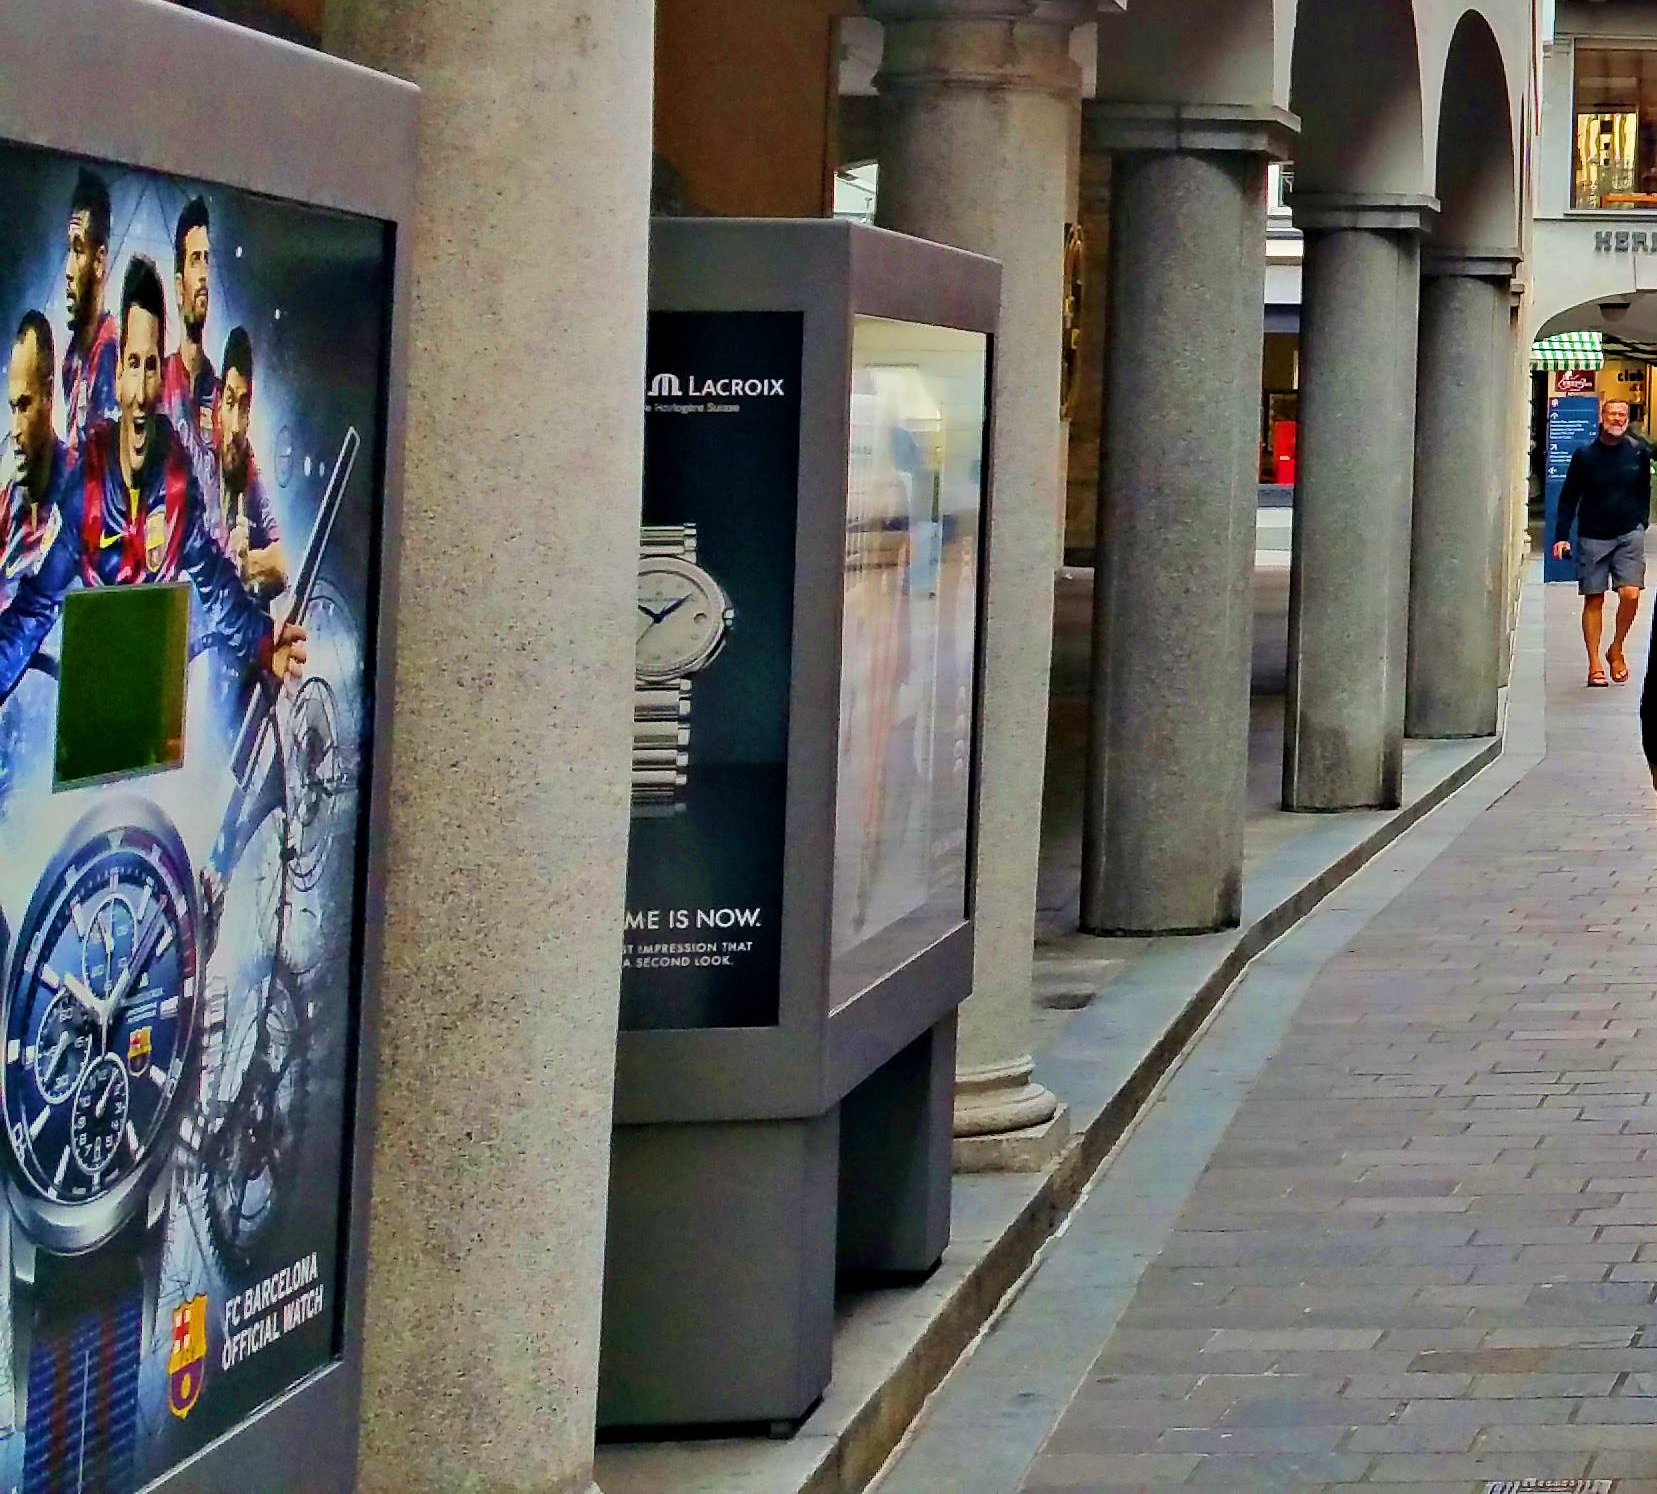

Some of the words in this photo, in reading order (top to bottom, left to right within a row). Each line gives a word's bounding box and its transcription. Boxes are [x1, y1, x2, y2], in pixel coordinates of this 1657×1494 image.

[688, 375, 785, 397] LACROIX
[623, 909, 661, 930] ME
[669, 909, 690, 930] IS
[696, 907, 762, 929] NOW.
[722, 941, 753, 953] THAT
[636, 956, 691, 969] SECOND
[225, 1294, 242, 1327] FC
[243, 1251, 318, 1320] BARCELONA
[221, 1311, 282, 1371] OFFICIAL
[283, 1283, 325, 1334] WATCH
